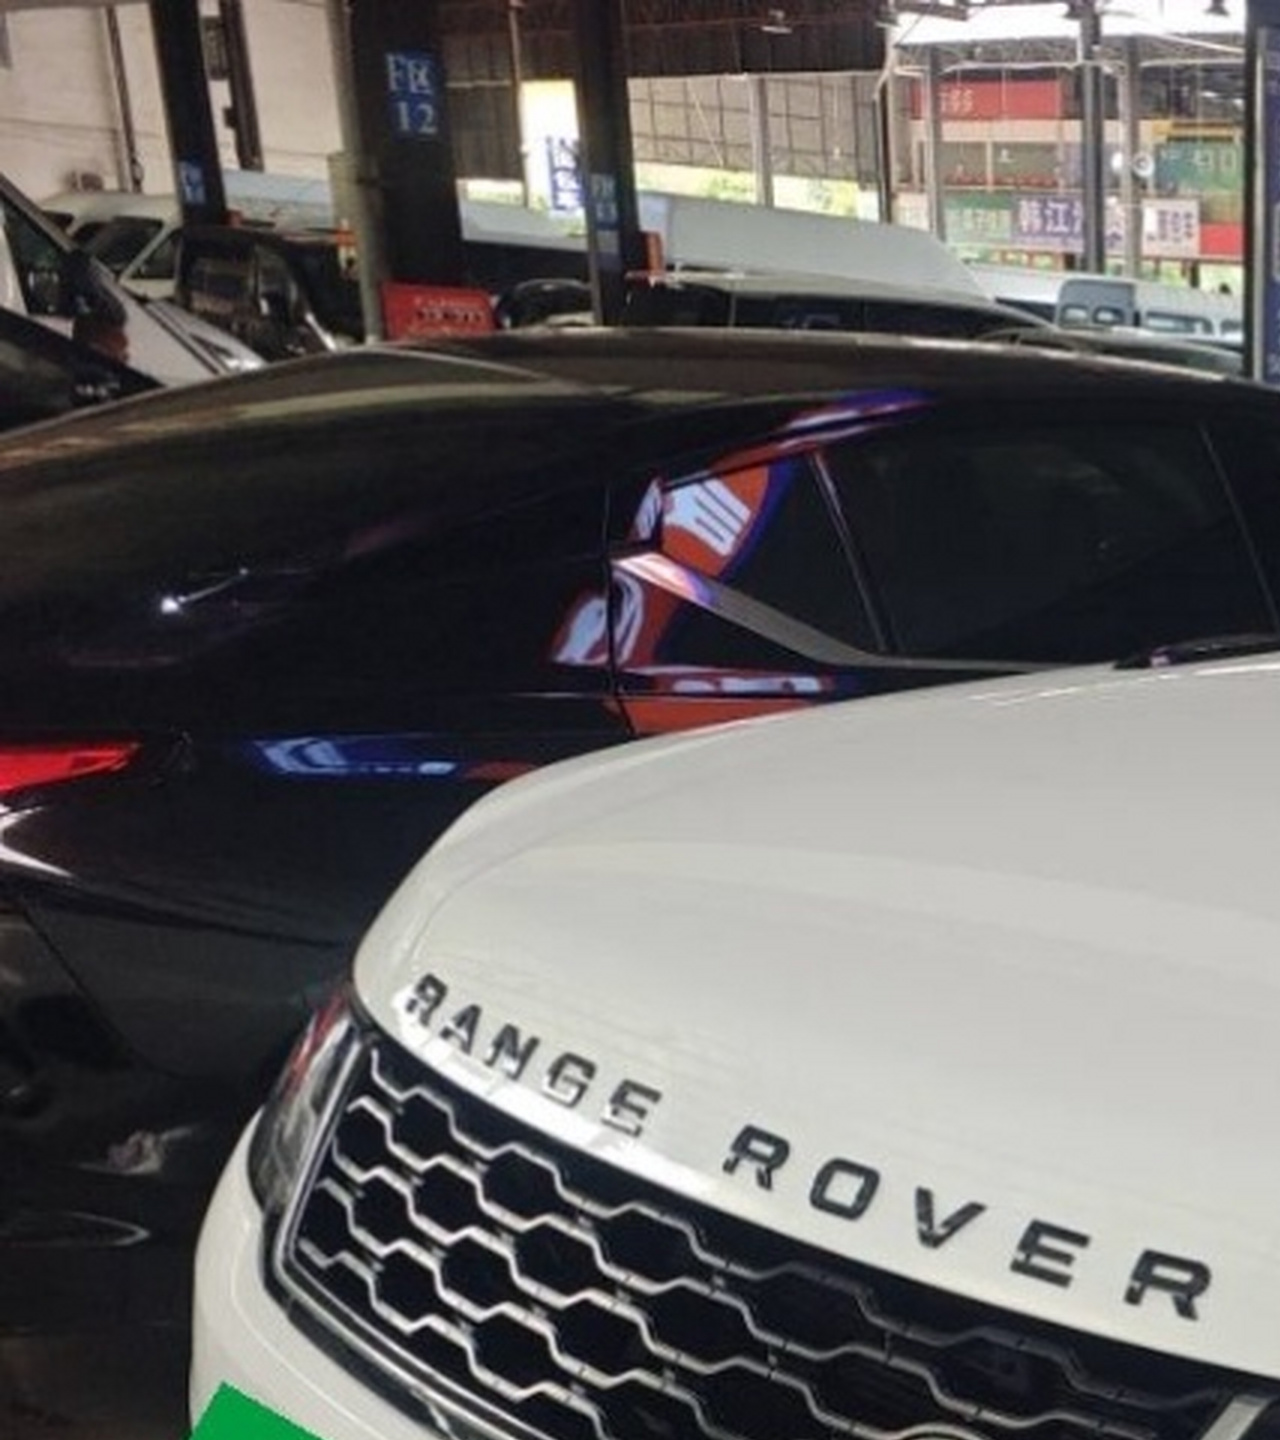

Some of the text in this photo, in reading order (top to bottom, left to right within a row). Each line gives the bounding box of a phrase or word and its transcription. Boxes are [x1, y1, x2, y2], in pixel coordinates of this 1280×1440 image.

[398, 101, 437, 133] 12
[404, 973, 1213, 1322] RANGE ROVER
